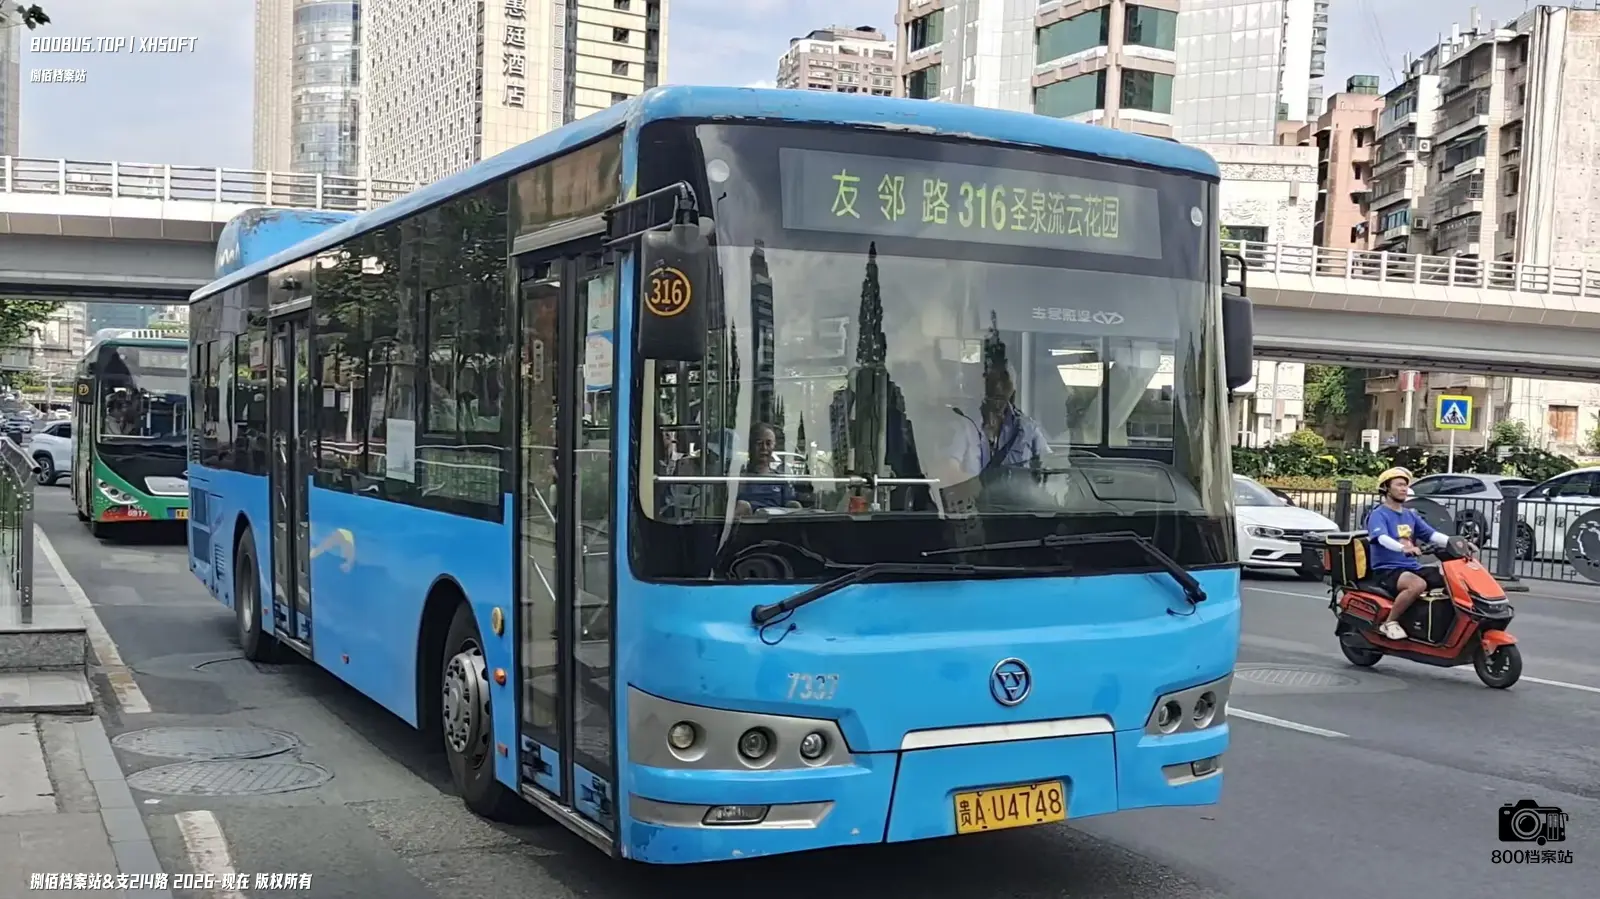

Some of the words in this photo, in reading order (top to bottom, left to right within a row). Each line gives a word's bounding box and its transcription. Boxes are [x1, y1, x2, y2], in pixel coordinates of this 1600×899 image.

[831, 168, 950, 225] 友邻路
[958, 181, 1007, 231] 316
[1010, 187, 1120, 239] 圣泉流云花园
[651, 278, 683, 305] 316
